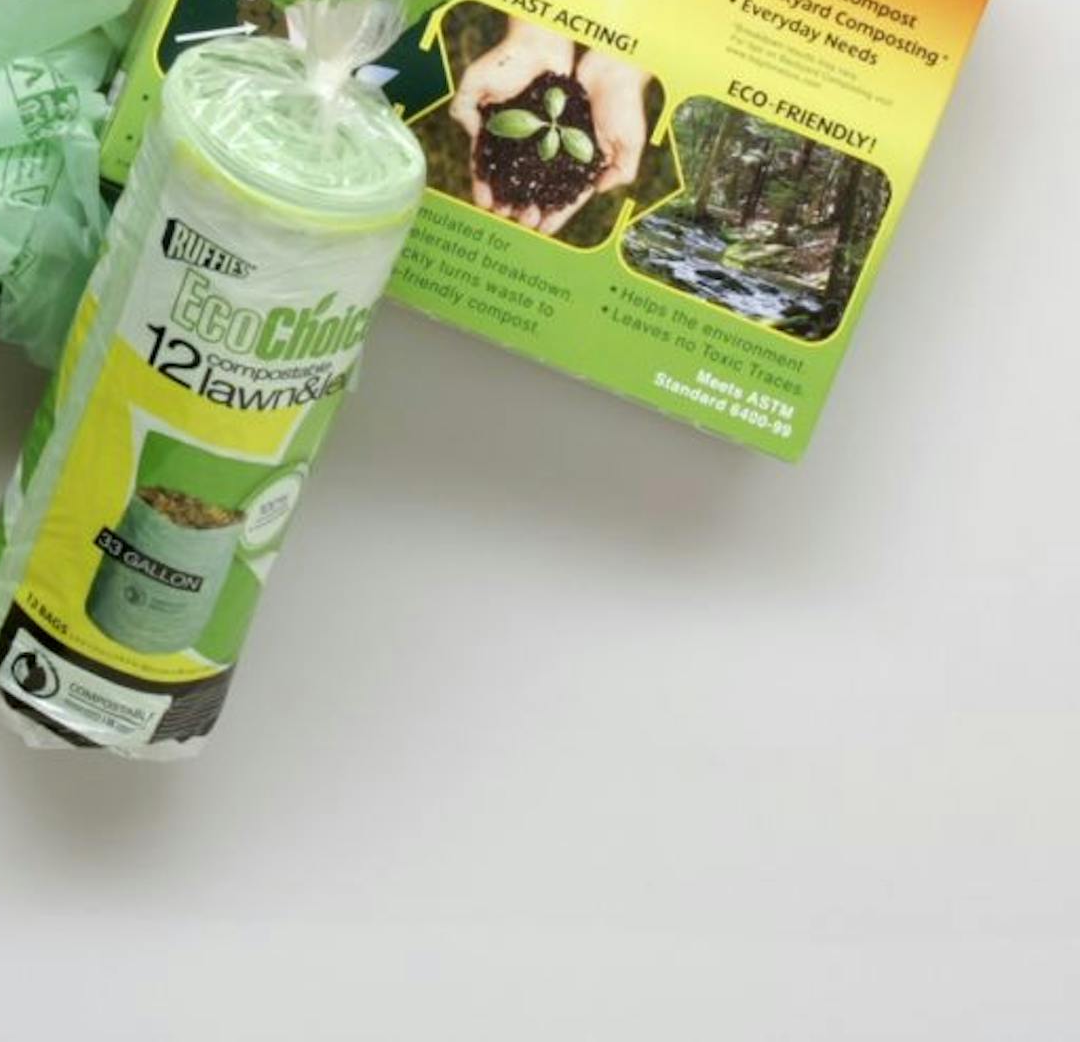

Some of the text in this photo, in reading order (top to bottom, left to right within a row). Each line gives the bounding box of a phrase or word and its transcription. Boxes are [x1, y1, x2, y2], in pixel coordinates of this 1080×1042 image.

[553, 9, 640, 55] ACTING!
[824, 33, 879, 66] Needs
[727, 79, 877, 154] ECO-FRIENDLY!
[164, 218, 252, 279] RUFFIES
[416, 206, 512, 252] mulated for
[170, 267, 372, 363] EcoChoic
[438, 260, 482, 287] turns
[483, 281, 534, 309] waste
[536, 302, 555, 318] to
[619, 285, 669, 320] Helps
[672, 305, 701, 333] the
[147, 322, 202, 390] 12
[611, 307, 672, 346] Leaves
[674, 334, 699, 355] no
[699, 340, 745, 376] Toxic
[653, 370, 728, 416] Standard
[696, 367, 796, 421] Meets ASTM
[97, 531, 204, 593] 33 GALLON
[38, 604, 70, 636] BAGS
